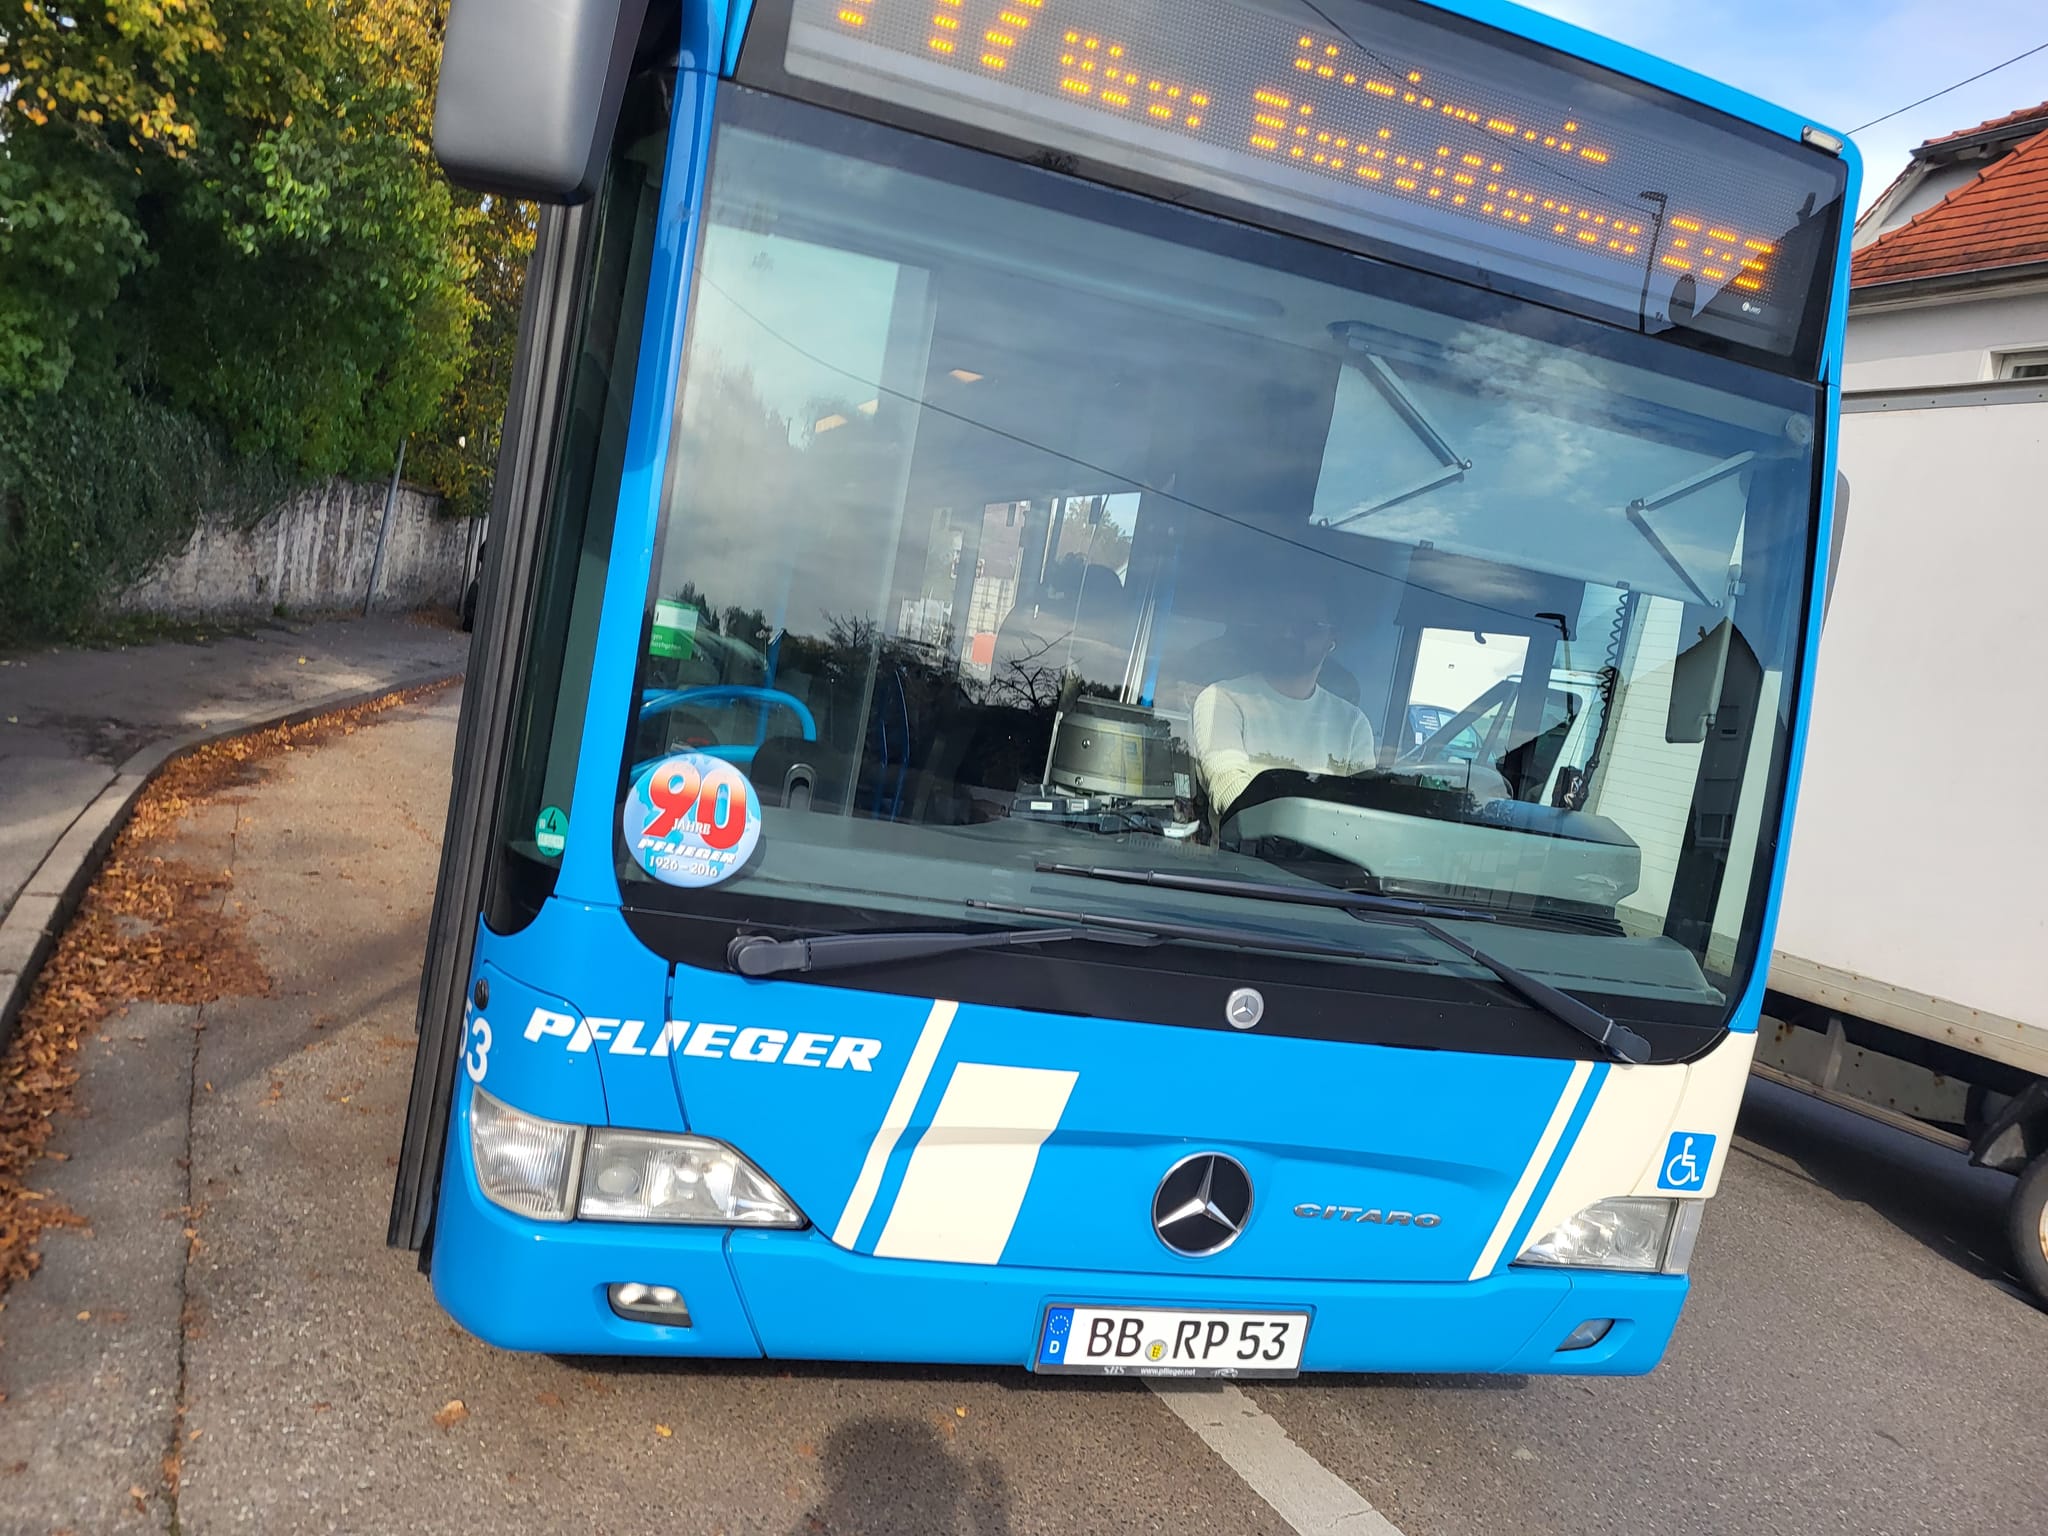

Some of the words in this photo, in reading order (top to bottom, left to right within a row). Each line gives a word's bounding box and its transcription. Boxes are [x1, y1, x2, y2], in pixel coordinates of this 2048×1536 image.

[642, 760, 747, 850] 90
[547, 809, 557, 832] 4
[638, 838, 737, 865] PFLIEGER
[522, 1006, 882, 1072] PFLIEGER
[1294, 1203, 1441, 1228] CITARO
[1049, 1340, 1060, 1354] D
[1087, 1317, 1144, 1357] BB
